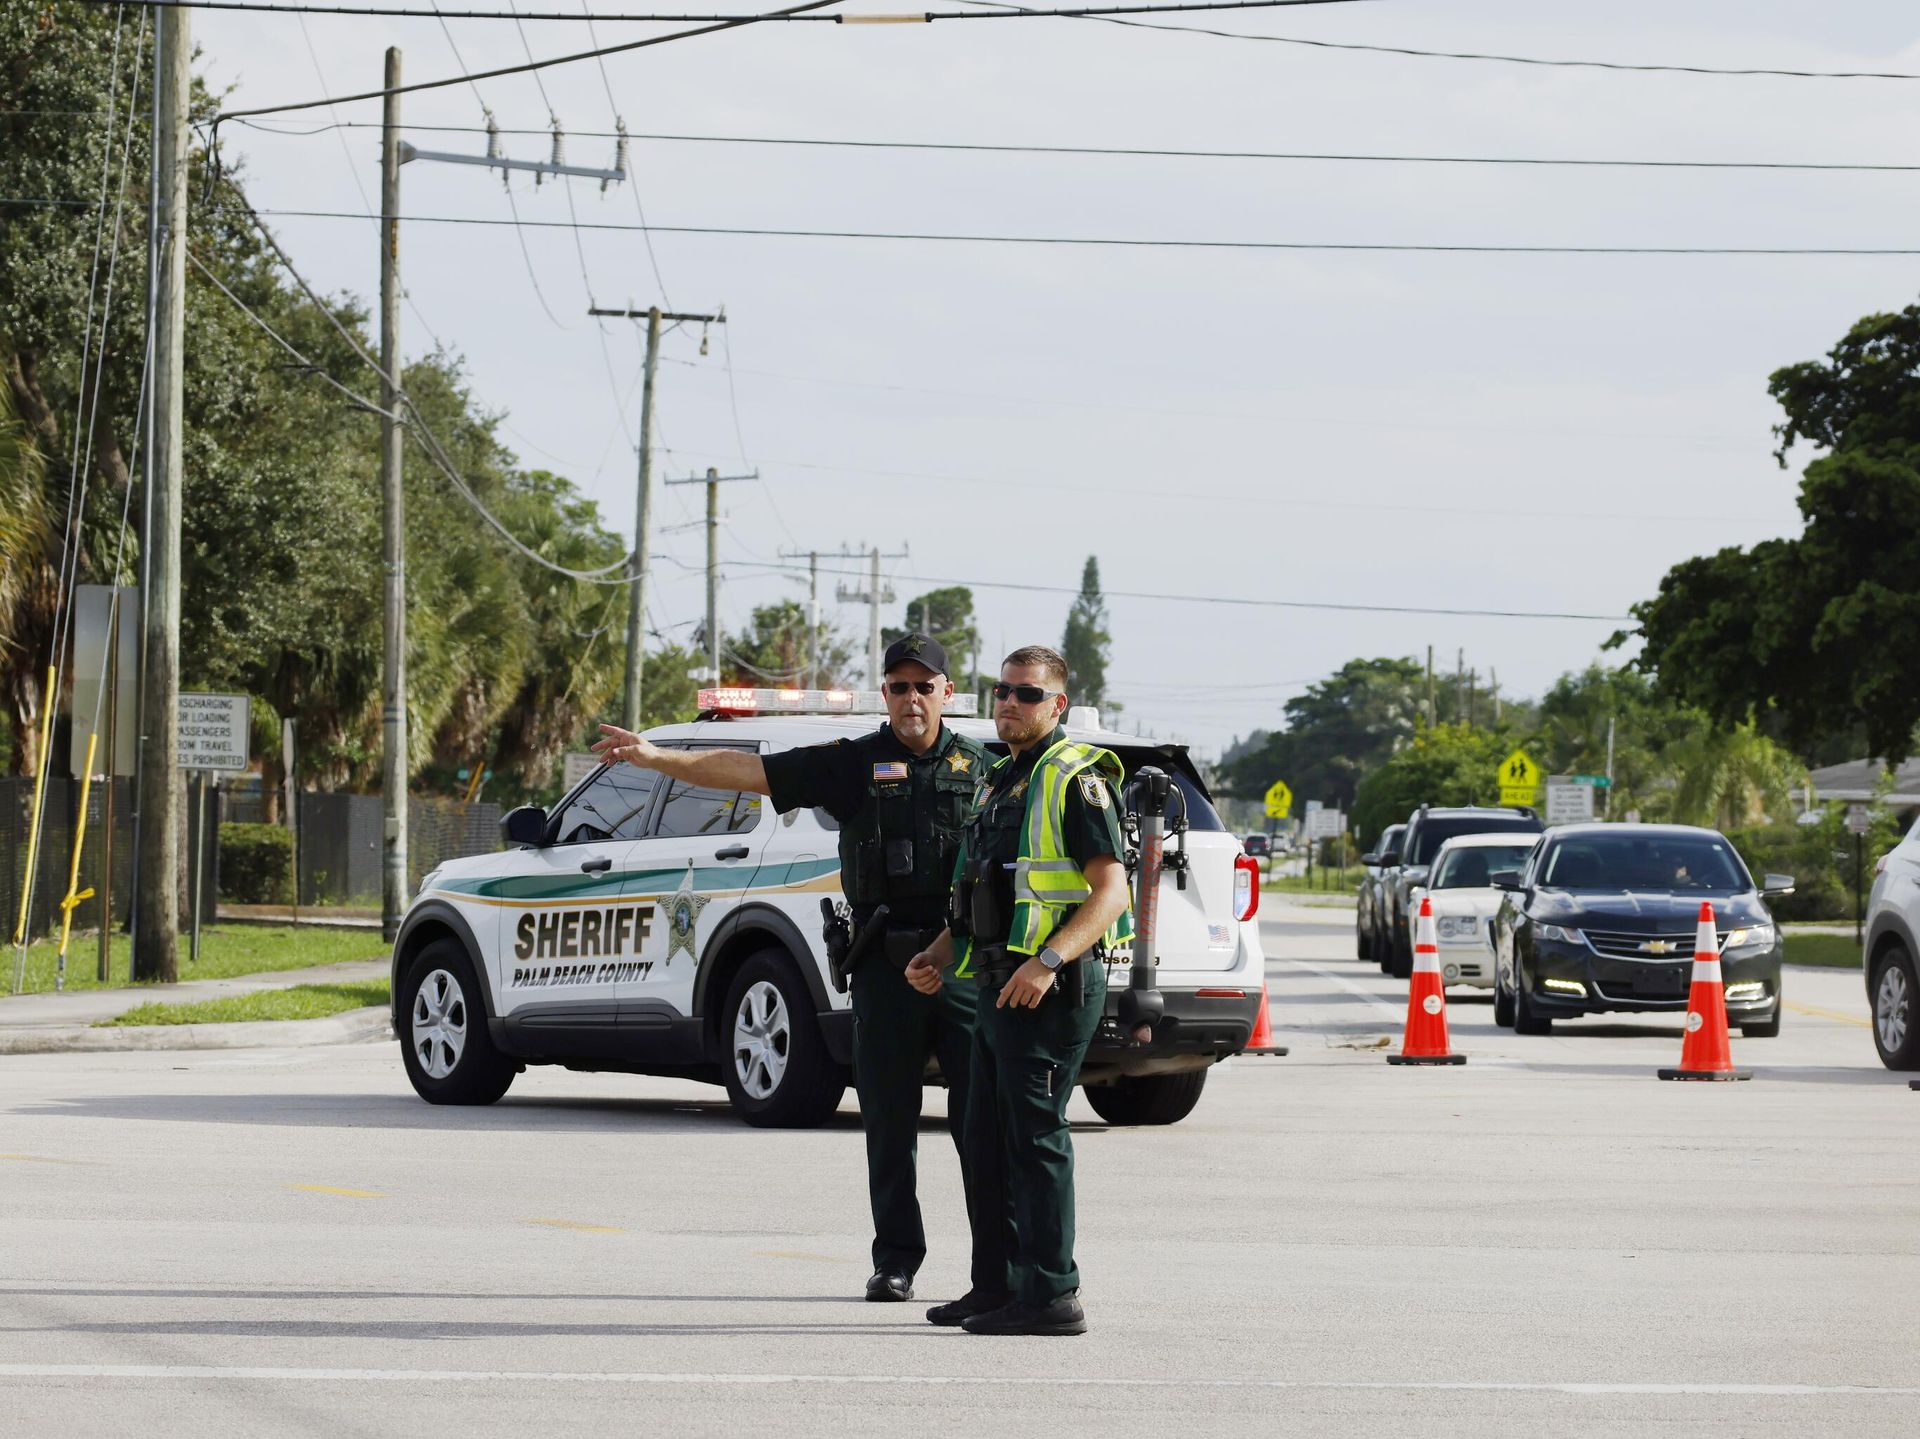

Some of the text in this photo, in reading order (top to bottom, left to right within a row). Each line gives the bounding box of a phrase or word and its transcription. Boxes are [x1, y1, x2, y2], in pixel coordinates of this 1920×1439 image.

[178, 698, 232, 710] ISCHARGING
[192, 712, 231, 723] LOADING
[178, 726, 232, 738] ASSENGERS
[178, 739, 233, 752] ROM TRAVEL
[193, 754, 244, 766] PROHIBITED
[514, 906, 656, 961] SHERIFF
[511, 961, 654, 988] PALM BEACH COUNTY
